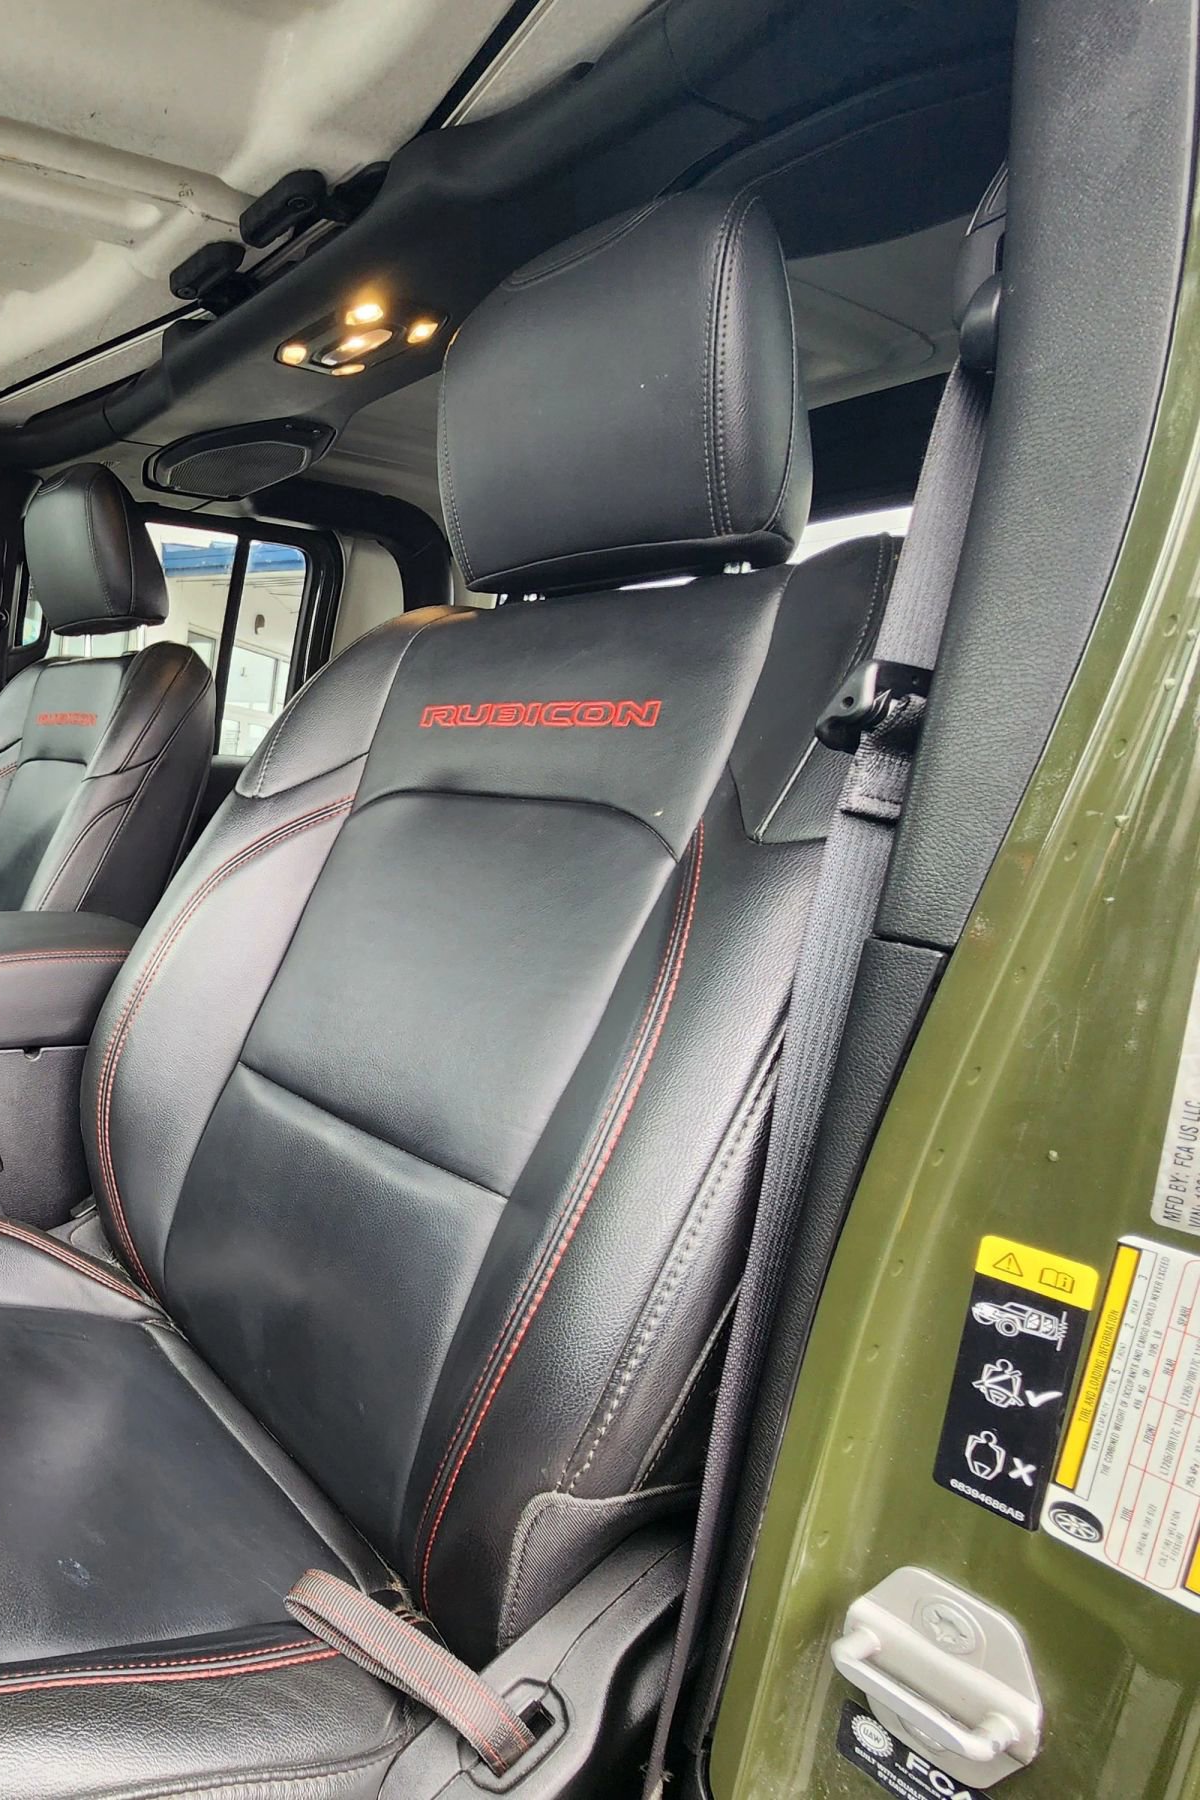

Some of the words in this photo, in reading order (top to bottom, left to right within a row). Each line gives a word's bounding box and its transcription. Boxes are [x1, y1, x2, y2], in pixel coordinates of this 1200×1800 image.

[420, 700, 662, 728] RUBICON
[1177, 1124, 1200, 1143] US
[1173, 1145, 1195, 1169] FCA
[1168, 1172, 1190, 1194] BY:
[1162, 1195, 1185, 1223] MFD
[1098, 1308, 1119, 1358] INFORMATION
[1089, 1358, 1105, 1390] LOADING
[1084, 1390, 1096, 1407] AND
[1079, 1407, 1091, 1423] TIRE
[949, 1478, 1026, 1522] 68394686AB
